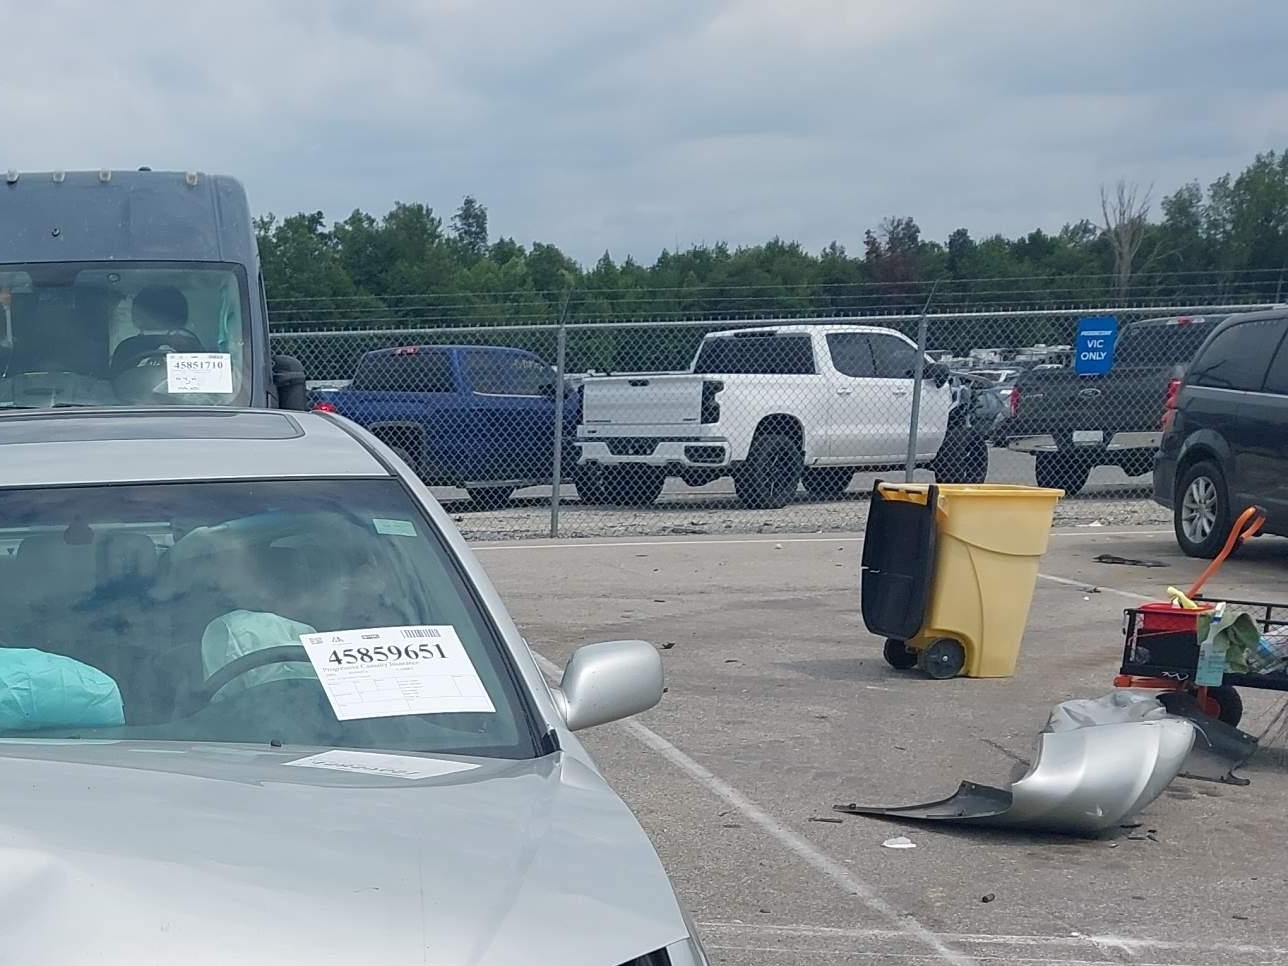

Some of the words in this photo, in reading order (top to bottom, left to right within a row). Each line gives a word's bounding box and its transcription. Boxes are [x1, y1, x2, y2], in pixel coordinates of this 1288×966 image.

[1087, 339, 1104, 348] VIC
[1080, 351, 1108, 360] ONLY
[175, 361, 224, 369] 45851710
[328, 643, 448, 665] 45859651
